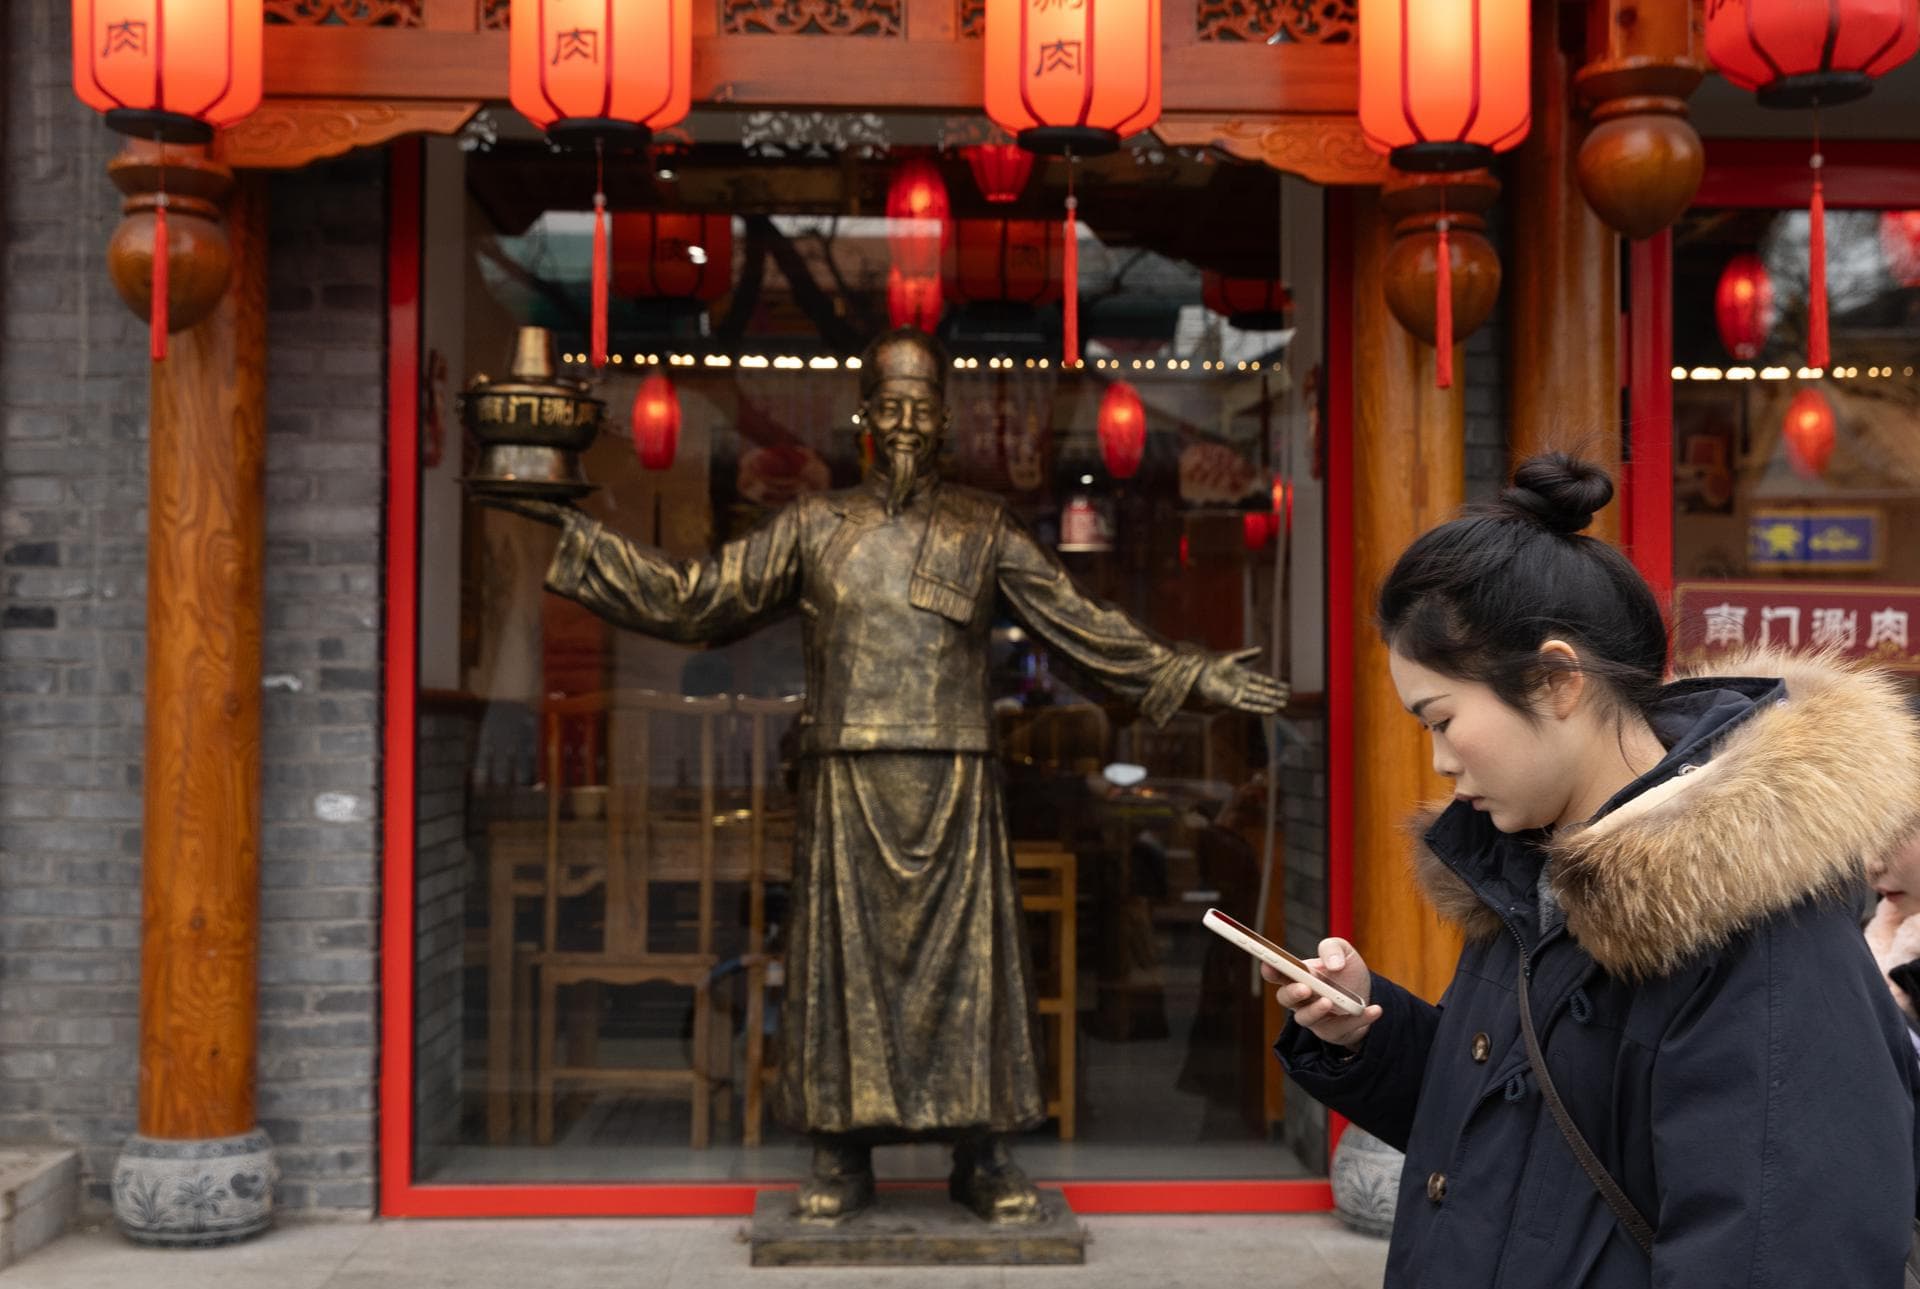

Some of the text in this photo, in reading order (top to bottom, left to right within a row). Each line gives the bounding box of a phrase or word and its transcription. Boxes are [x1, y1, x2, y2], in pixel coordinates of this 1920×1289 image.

[102, 20, 147, 58] 肉
[1703, 602, 1909, 649] 南门涮肉
